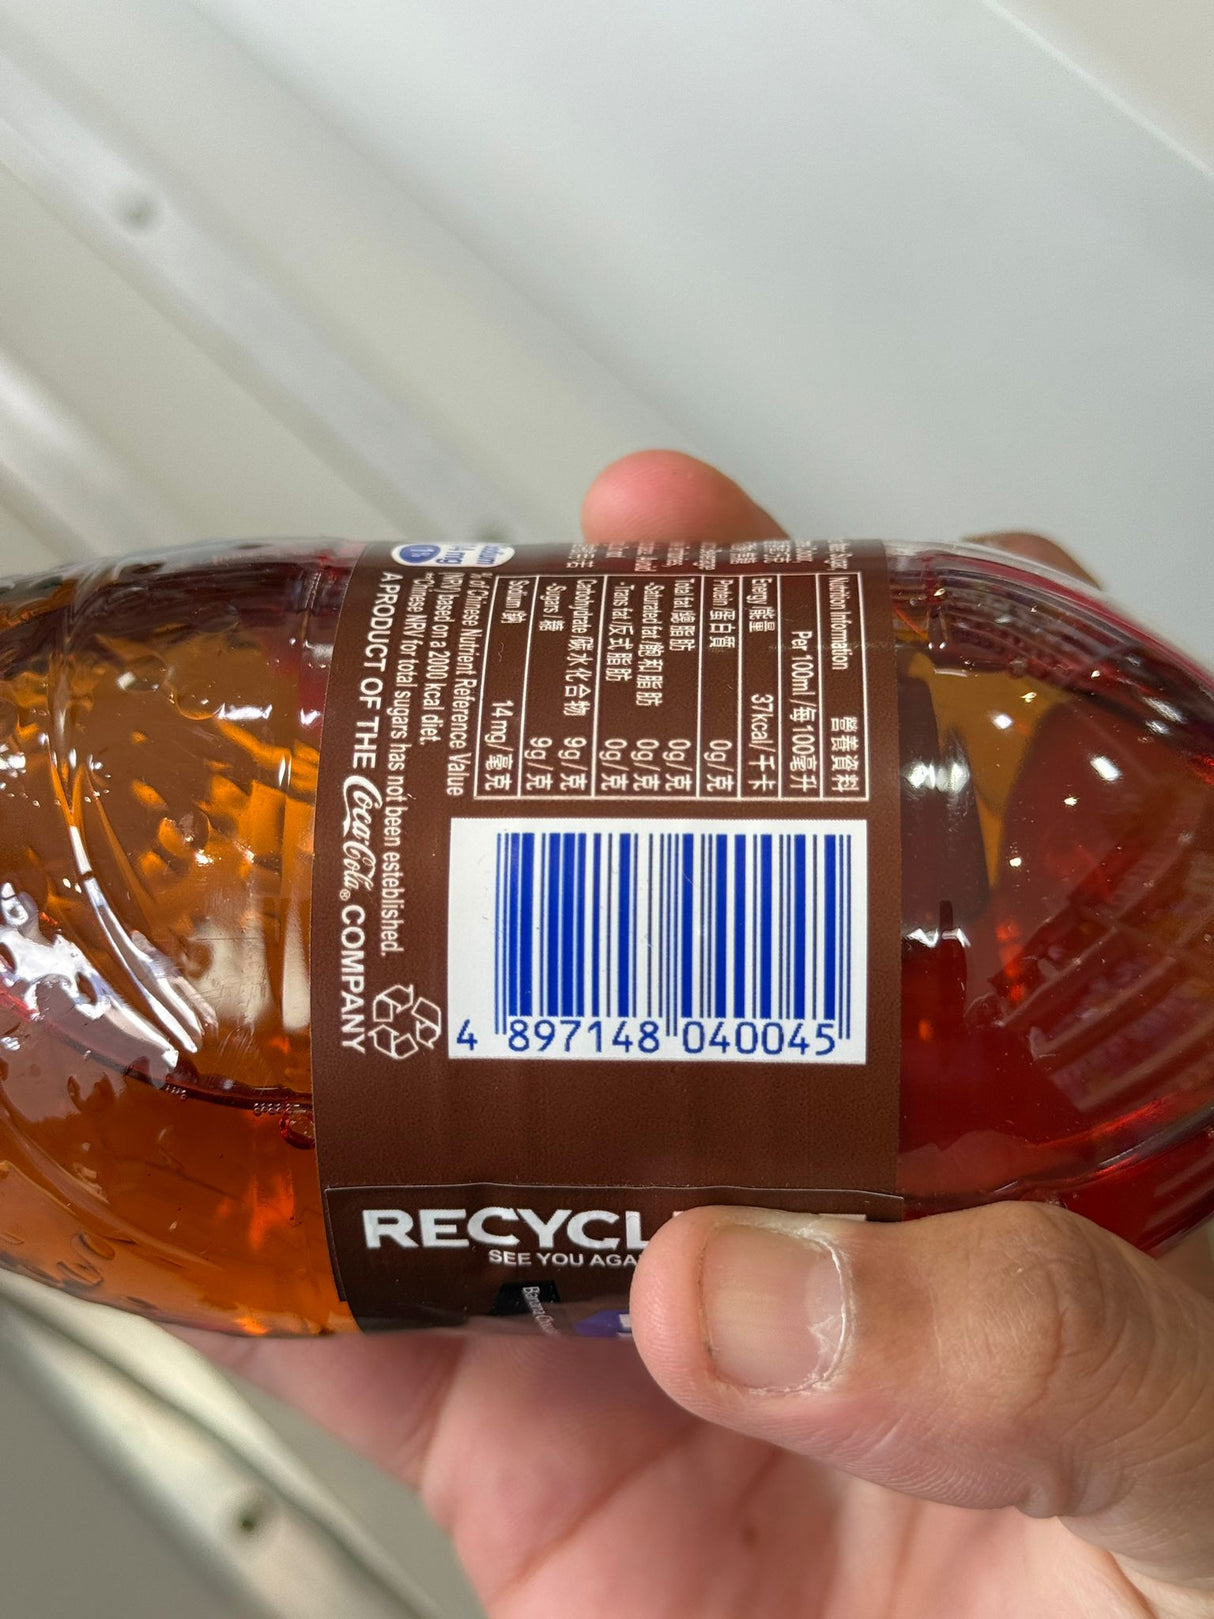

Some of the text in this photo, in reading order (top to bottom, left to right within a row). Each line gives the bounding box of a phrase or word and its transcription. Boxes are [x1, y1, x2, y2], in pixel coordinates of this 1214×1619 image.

[381, 571, 403, 582] A
[469, 579, 490, 590] of
[673, 578, 696, 597] Total
[712, 578, 734, 607] Protein
[746, 577, 773, 605] Energy
[462, 589, 490, 627] Chinese
[505, 580, 530, 608] Sodium
[568, 579, 598, 634] Carbohydrate
[641, 581, 666, 624] -Saturated
[672, 597, 695, 610] fat
[828, 577, 849, 611] Nutrition
[363, 584, 401, 672] PRODUCT
[402, 615, 428, 638] NRV
[611, 608, 634, 621] fat
[400, 639, 424, 656] for
[641, 624, 663, 640] fat
[791, 630, 813, 650] Per
[830, 611, 853, 671] Information
[419, 572, 466, 747] (NRV) based on a 2000 kcal diet.
[456, 628, 483, 676] Nutrient
[395, 659, 420, 687] total
[791, 655, 816, 697] 100ml
[359, 678, 384, 710] OF
[386, 691, 412, 739] sugars
[449, 678, 478, 750] Reference
[353, 716, 379, 769] THE
[388, 743, 412, 771] has
[830, 716, 860, 792] 營養資料
[386, 776, 409, 802] not
[446, 752, 472, 797] Value
[384, 807, 409, 847] been
[340, 905, 366, 1054] COMPANY
[456, 1019, 836, 1056] 4 897148 040045
[362, 1206, 685, 1250] RECYCL
[488, 1250, 532, 1267] SEE
[536, 1251, 584, 1267] YOU
[522, 1286, 546, 1315] Banana
